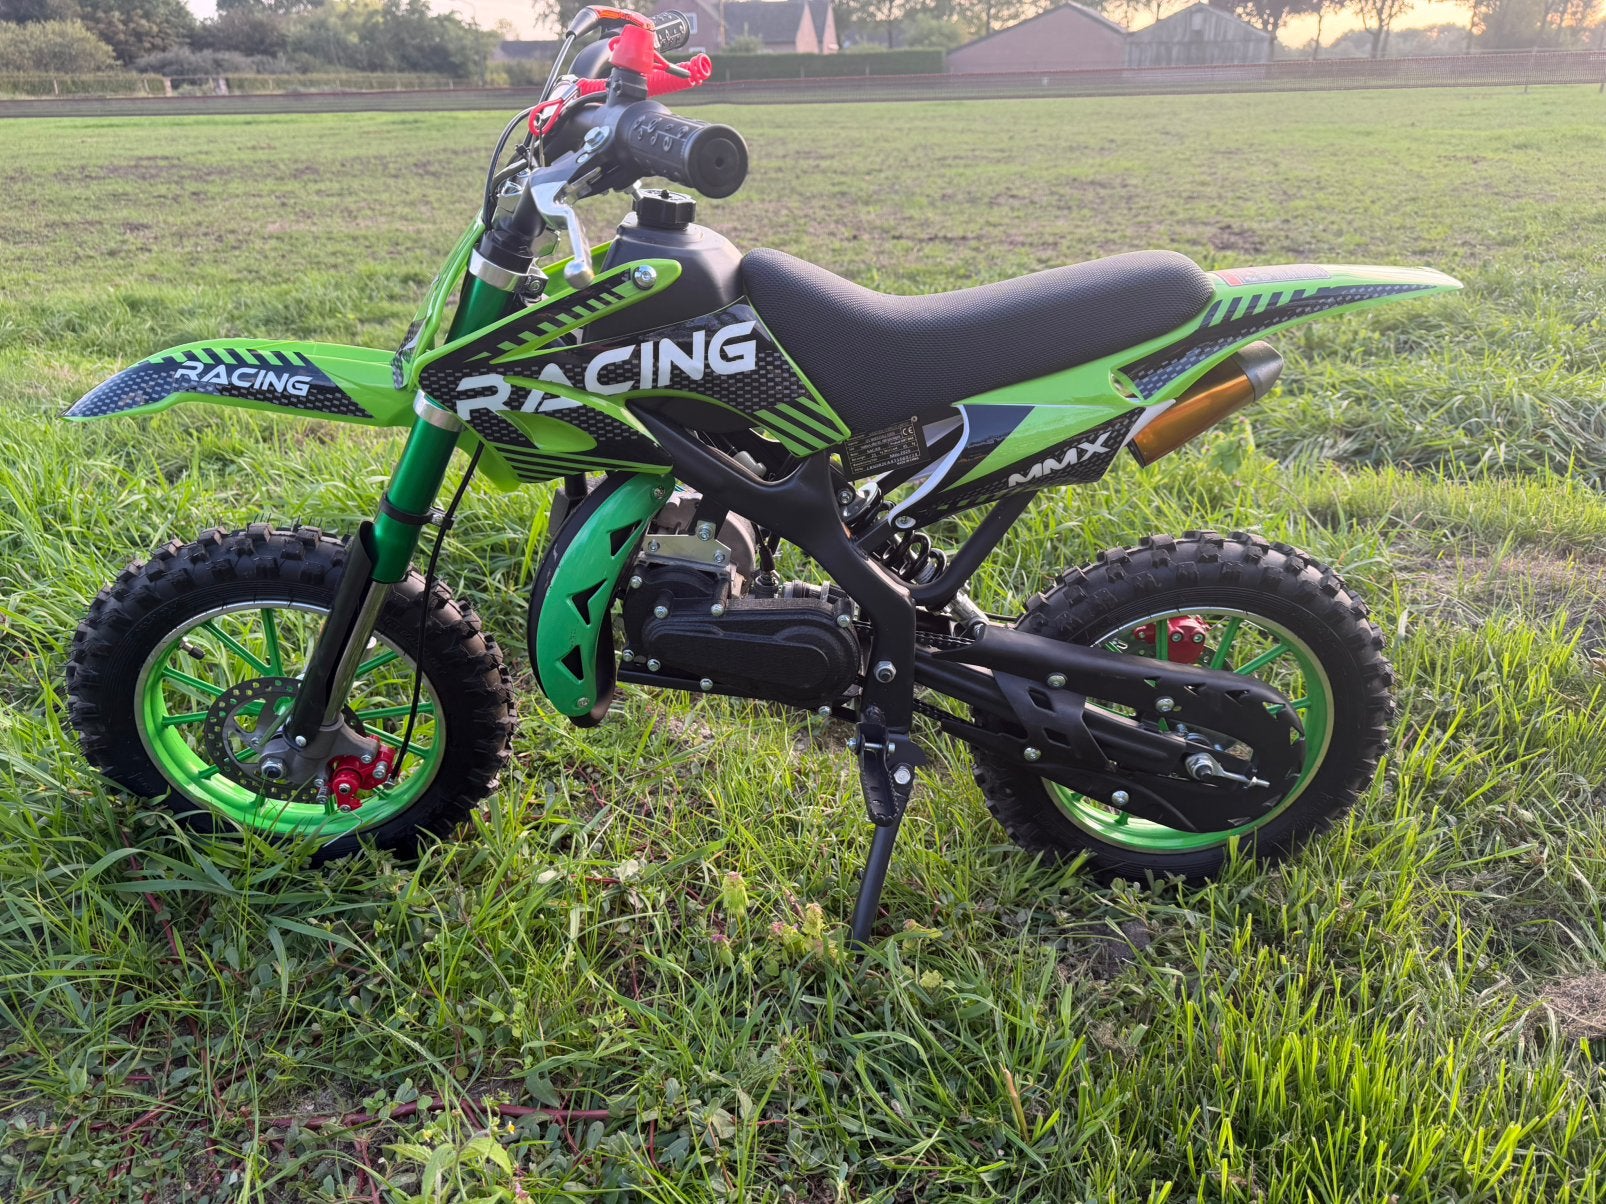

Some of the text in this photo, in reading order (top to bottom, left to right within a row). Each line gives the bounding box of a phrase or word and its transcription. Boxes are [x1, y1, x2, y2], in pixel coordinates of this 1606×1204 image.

[174, 360, 313, 397] RACING
[455, 320, 757, 420] RACING
[1008, 431, 1112, 488] MMX
